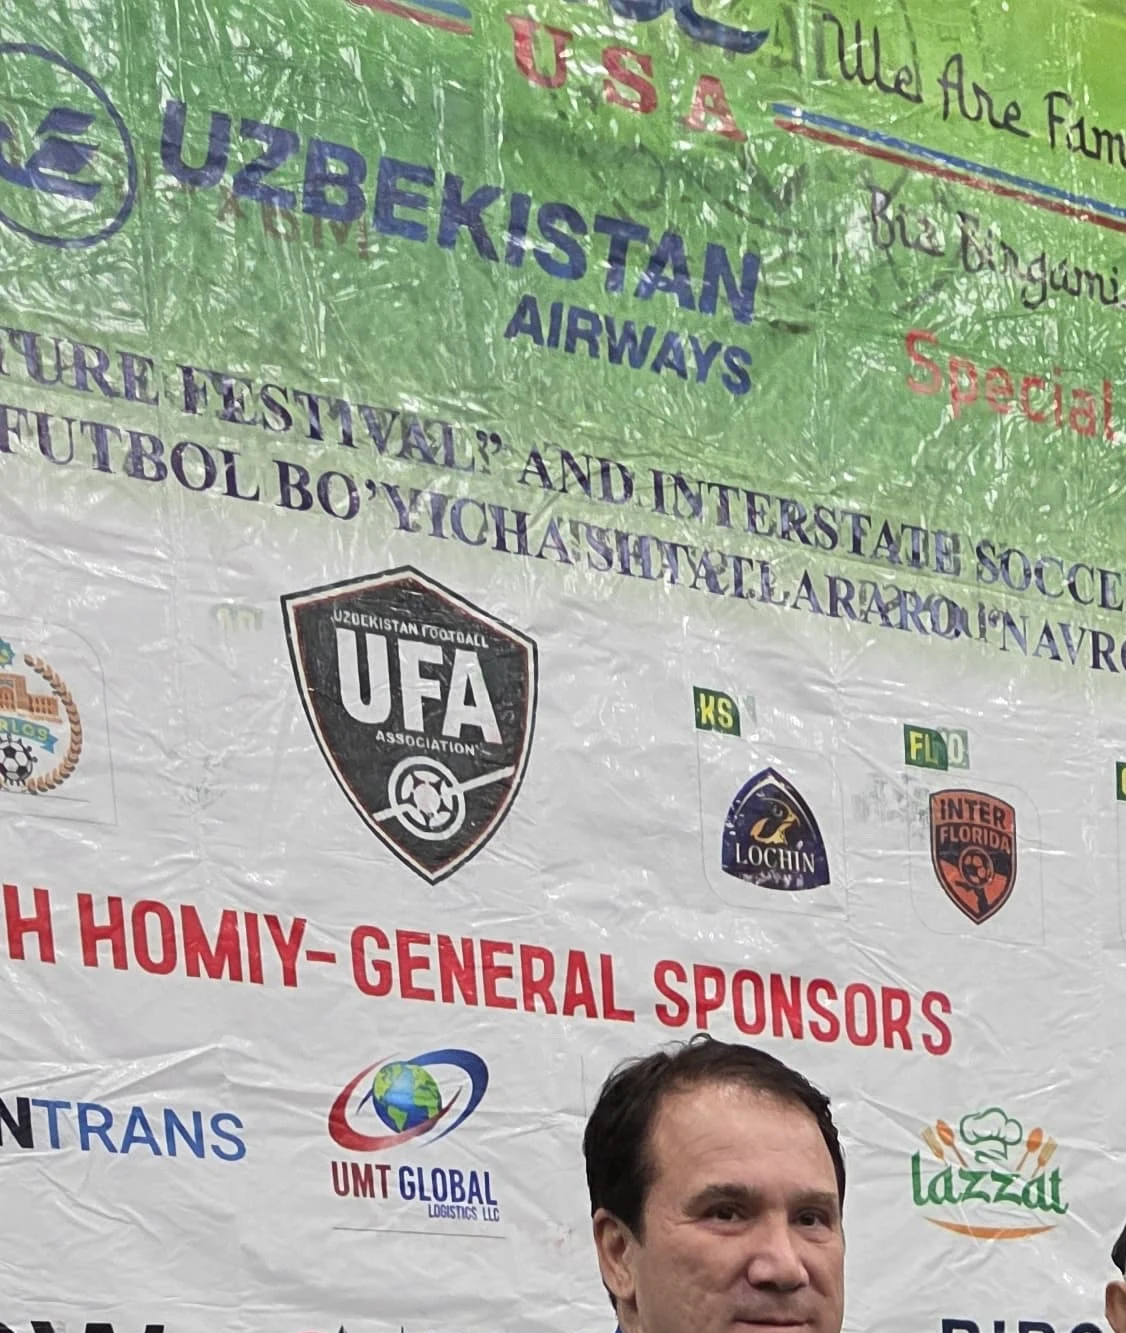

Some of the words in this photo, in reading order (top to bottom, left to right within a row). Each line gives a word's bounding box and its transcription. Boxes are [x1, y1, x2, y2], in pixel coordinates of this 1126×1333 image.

[160, 101, 762, 325] UZBEKISTAN
[504, 295, 753, 396] AIRWAYS
[904, 329, 1117, 442] Special
[0, 404, 261, 502] FUTBOL
[517, 441, 635, 505] AND
[649, 469, 962, 577] INTERSTATE
[333, 608, 419, 637] UZBEKISTAN
[421, 624, 489, 649] FOOTBALL
[336, 627, 503, 745] UFA
[700, 692, 734, 729] KS
[375, 730, 476, 756] ASSOCIATION
[909, 730, 939, 764] FL
[939, 797, 1007, 830] INTER
[735, 842, 816, 874] LOCHIN
[939, 825, 1011, 855] FLORIDA
[3, 884, 56, 964] H
[652, 959, 953, 1056] SPONSORS
[0, 1096, 247, 1162] NTRANS
[331, 1161, 392, 1200] UMT
[399, 1165, 498, 1206] GLOBAL
[428, 1202, 478, 1221] LOGISTICS
[482, 1206, 500, 1223] LLC
